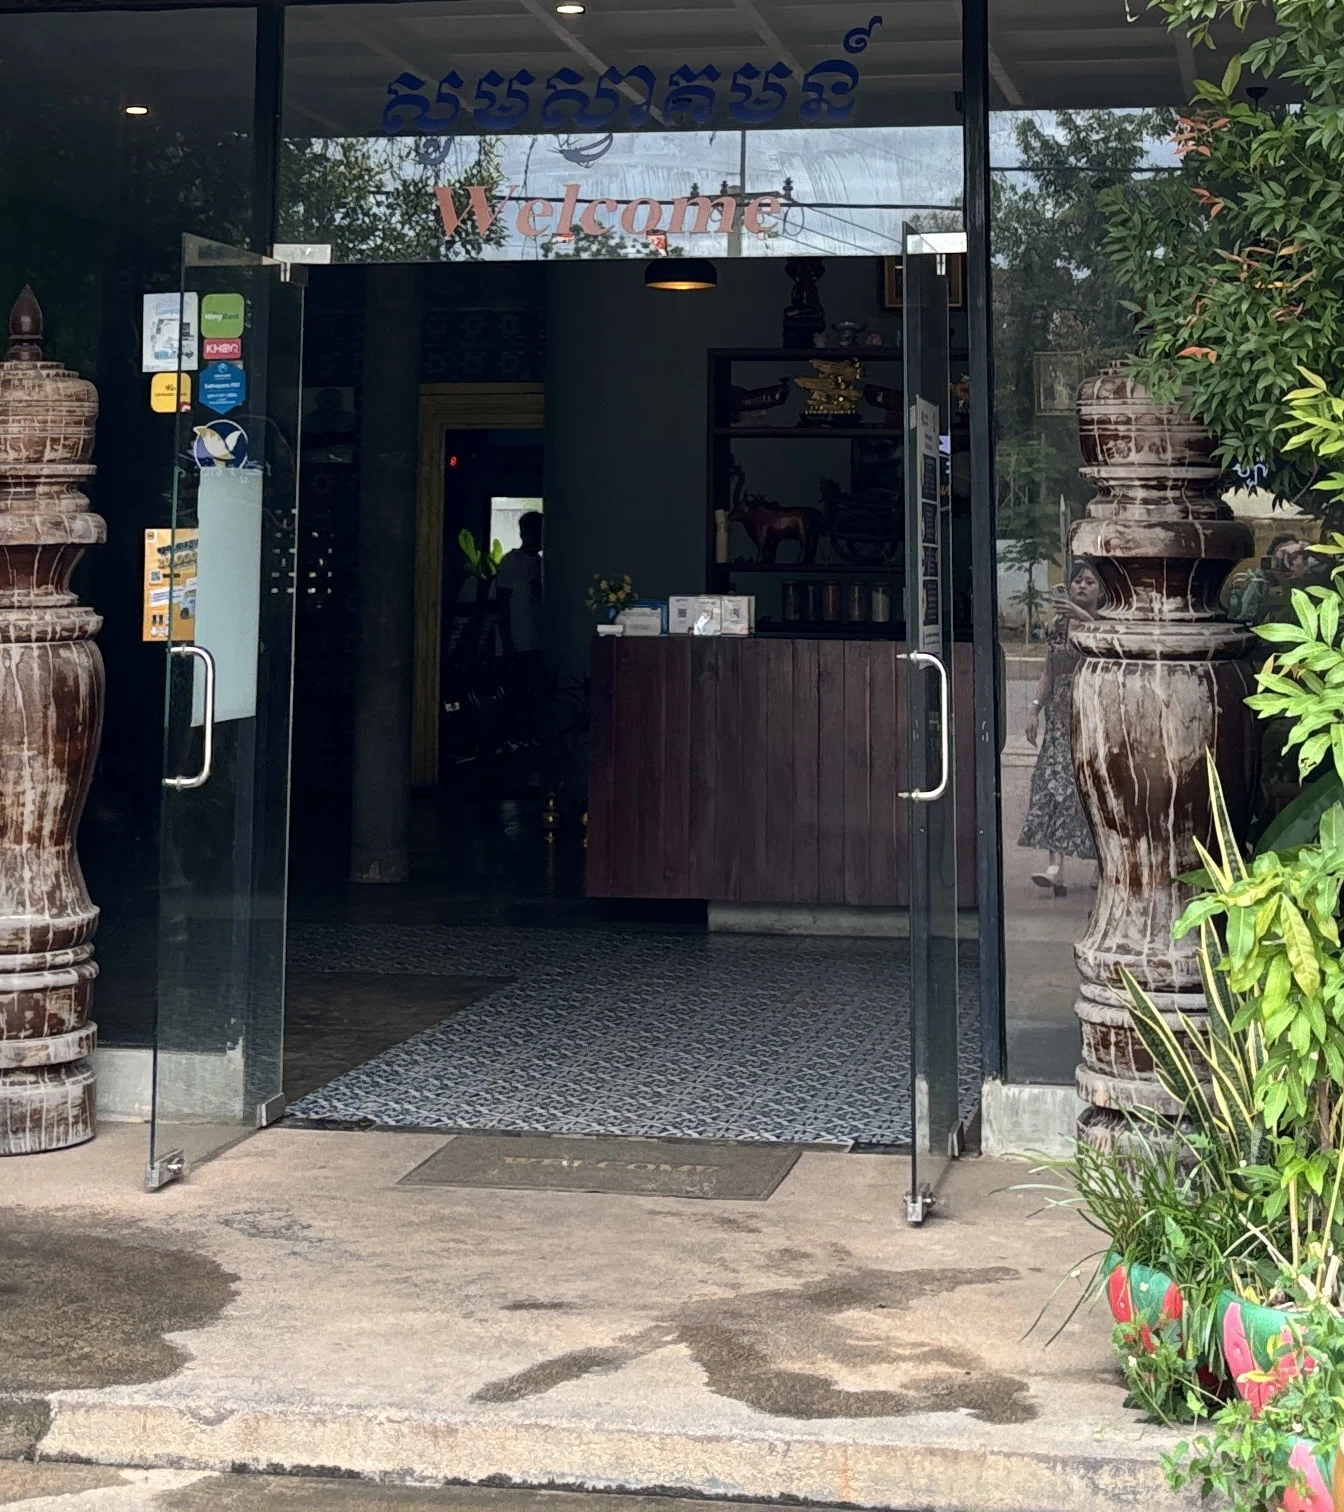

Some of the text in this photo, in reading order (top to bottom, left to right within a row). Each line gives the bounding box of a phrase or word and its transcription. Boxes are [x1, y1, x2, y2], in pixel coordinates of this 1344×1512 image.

[381, 15, 883, 166] សូមស្វាគមន៍
[434, 184, 781, 237] Welcome
